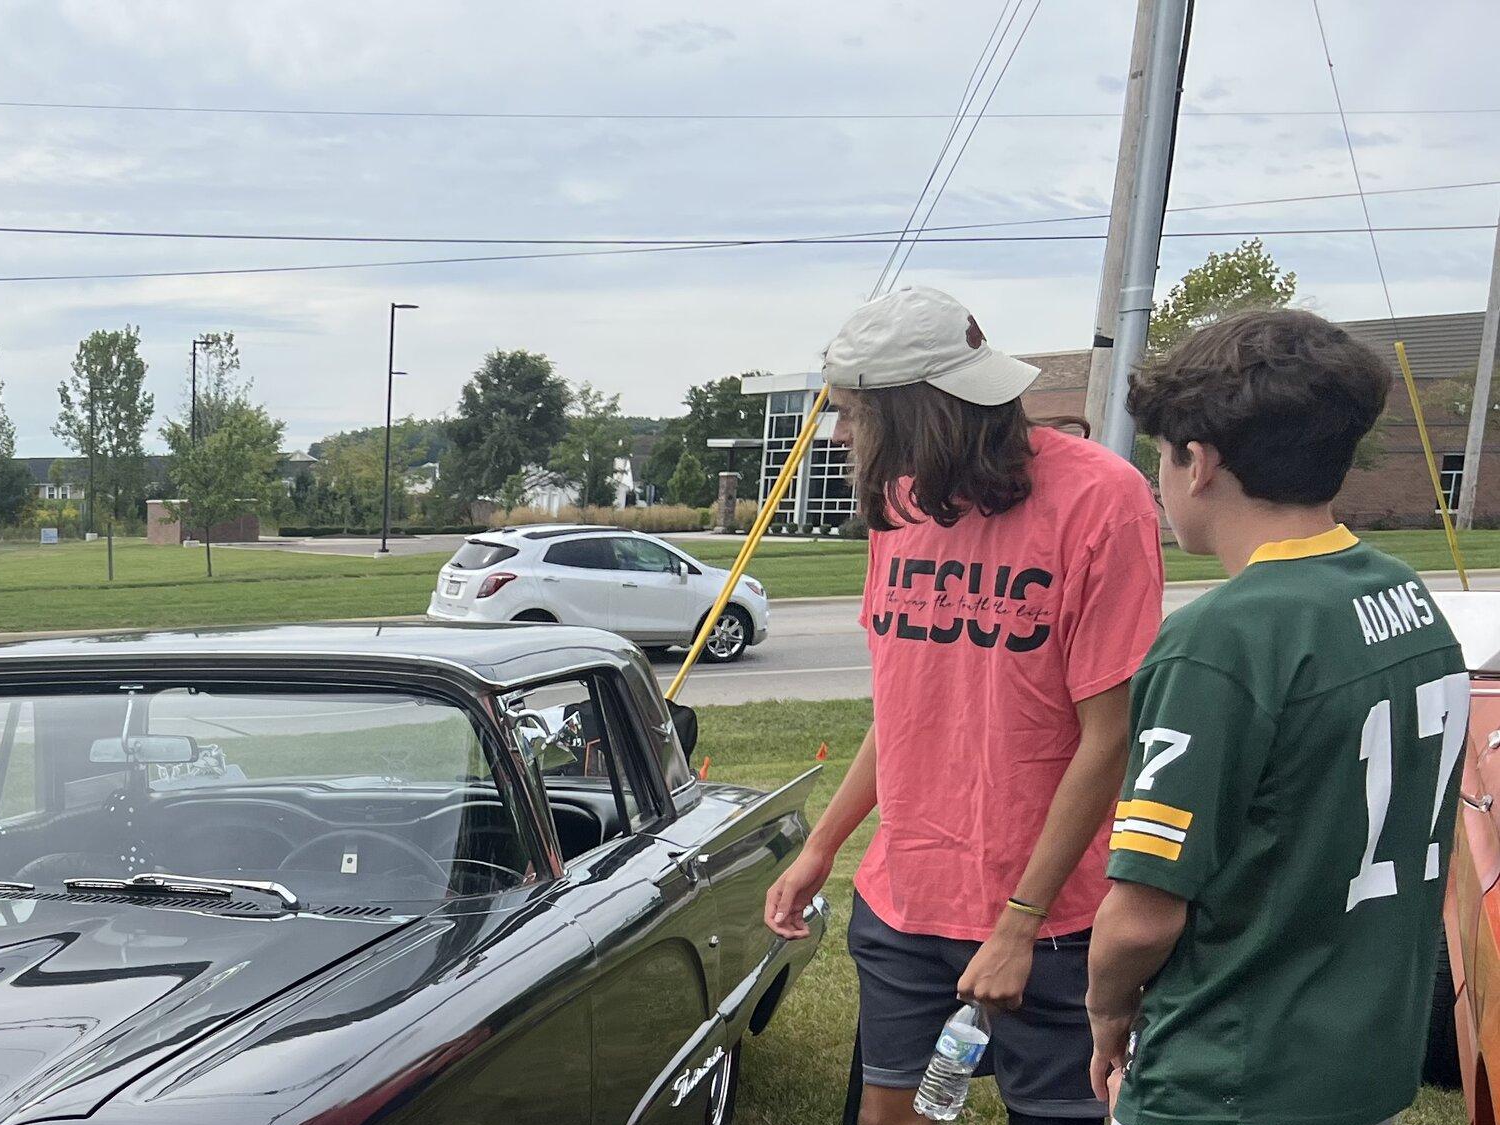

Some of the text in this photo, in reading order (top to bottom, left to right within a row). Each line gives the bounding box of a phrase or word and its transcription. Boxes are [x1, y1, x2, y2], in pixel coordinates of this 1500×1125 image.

[872, 557, 1054, 653] JESUS
[1352, 580, 1435, 646] ADAMS
[1346, 671, 1471, 913] 17
